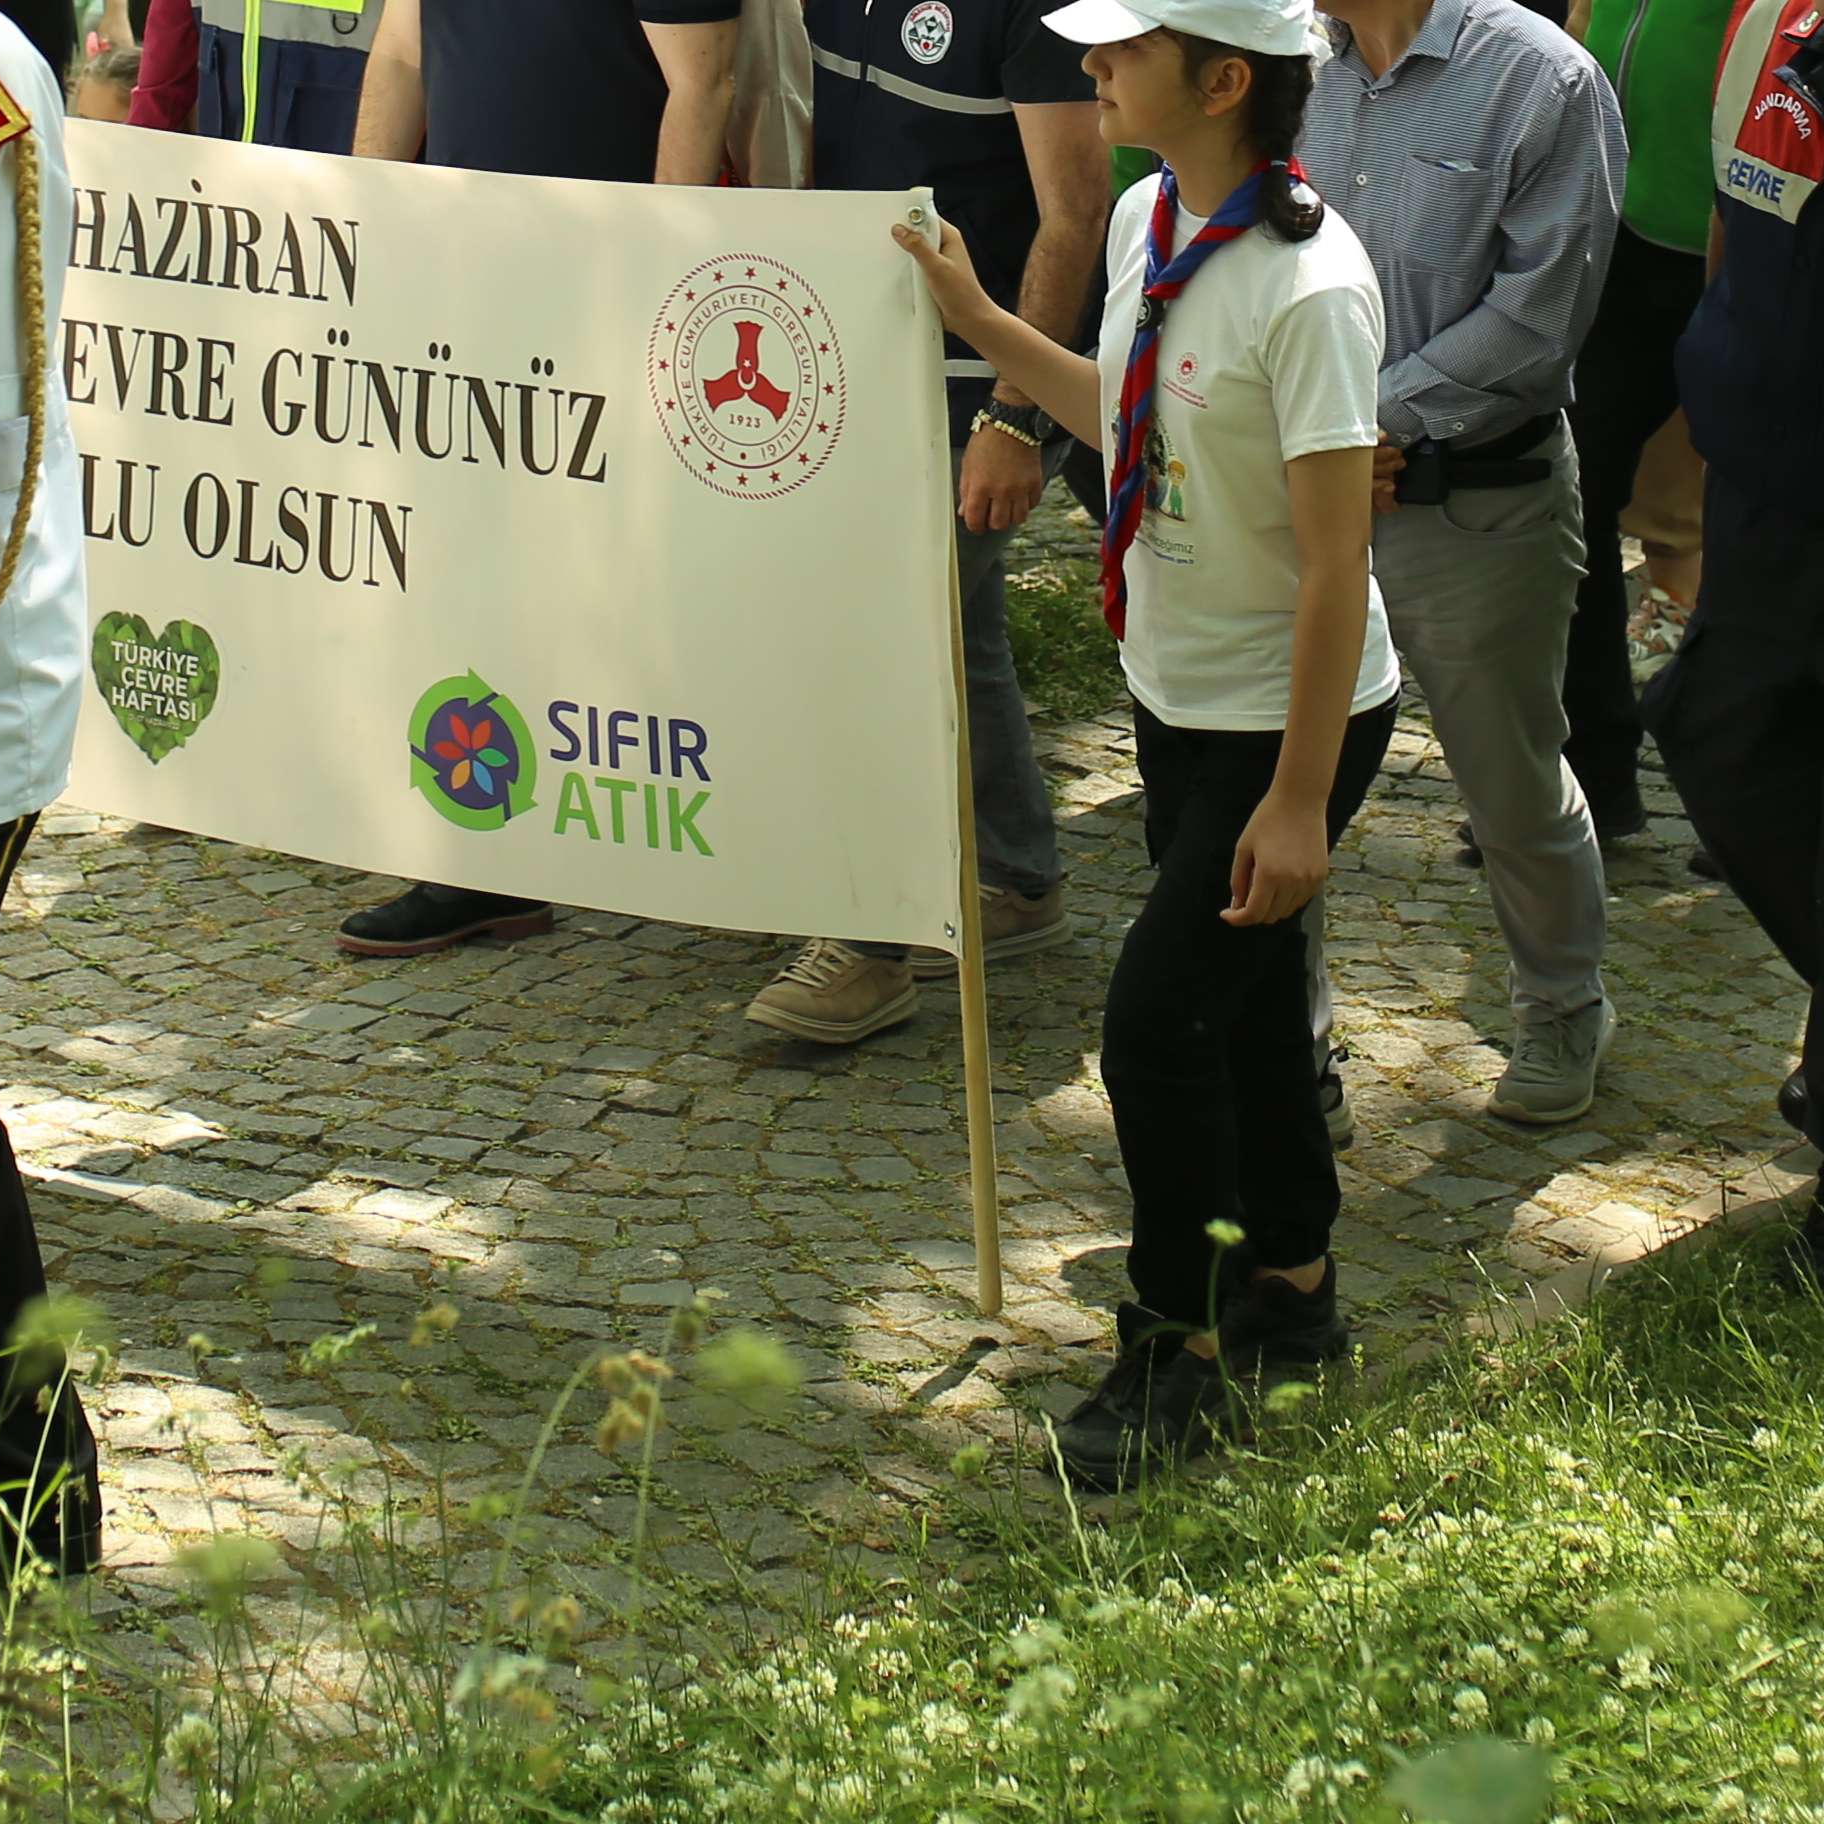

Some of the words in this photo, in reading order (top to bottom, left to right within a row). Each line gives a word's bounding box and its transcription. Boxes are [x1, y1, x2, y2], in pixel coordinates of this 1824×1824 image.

[1754, 92, 1812, 140] JANDARMA
[1726, 158, 1786, 204] ÇEVRE
[68, 179, 360, 307] HAZİRAN
[680, 293, 767, 370] CUMHURİYETİ
[772, 305, 813, 385] GİRESUN
[62, 318, 235, 426] EVRE
[261, 328, 607, 483] GÜNÜNÜZ
[682, 379, 727, 452] TÜRKİYE
[729, 413, 762, 429] 1923
[760, 396, 813, 462] VALİLİĞİ
[79, 453, 161, 547] LU
[183, 472, 413, 594] OLSUN
[111, 639, 199, 677] TÜRKİYE
[121, 666, 188, 698] ÇEVRE
[112, 686, 197, 722] HAFTASI
[548, 700, 712, 782] SIFIR
[553, 771, 715, 858] ATIK
